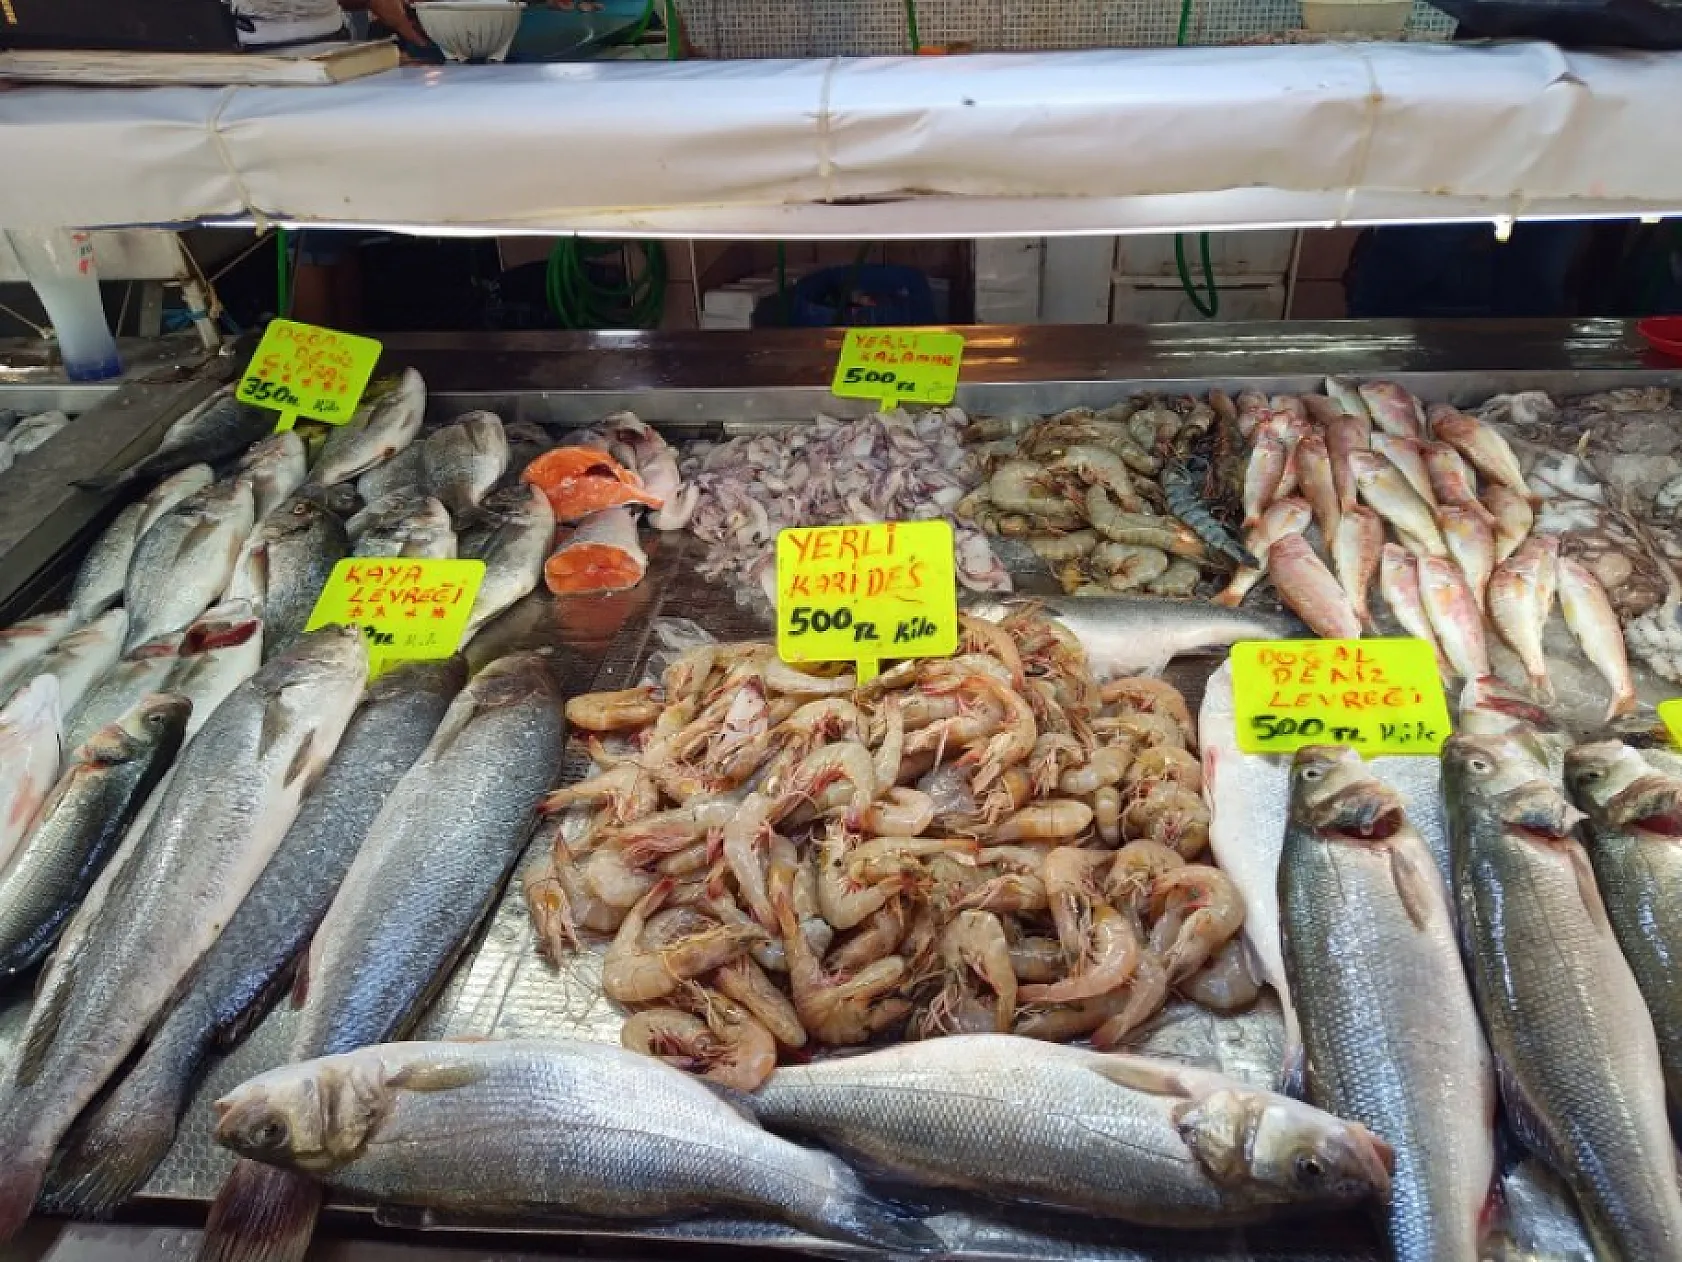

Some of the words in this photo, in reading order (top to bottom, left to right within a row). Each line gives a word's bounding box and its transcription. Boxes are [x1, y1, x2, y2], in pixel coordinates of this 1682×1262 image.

[788, 523, 896, 562] YERLİ
[345, 564, 423, 586] KAYA
[347, 579, 465, 604] LEVREĞİ
[893, 616, 938, 644] Kilo
[1268, 687, 1423, 708] LEVREĞİ
